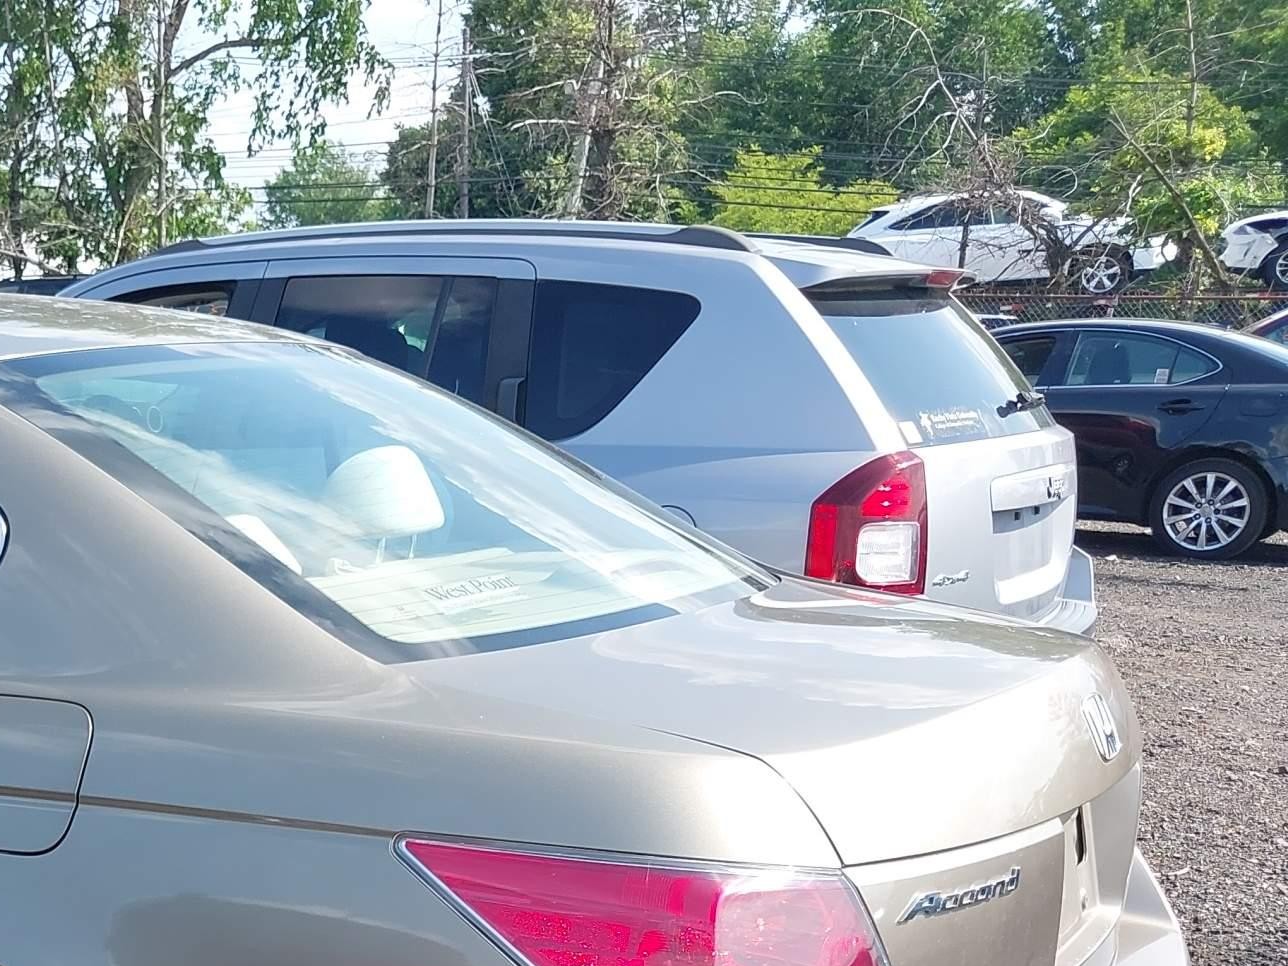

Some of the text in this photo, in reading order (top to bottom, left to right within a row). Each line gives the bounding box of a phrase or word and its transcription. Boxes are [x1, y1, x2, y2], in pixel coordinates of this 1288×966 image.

[424, 576, 517, 600] West Point
[895, 866, 1022, 926] Accord
